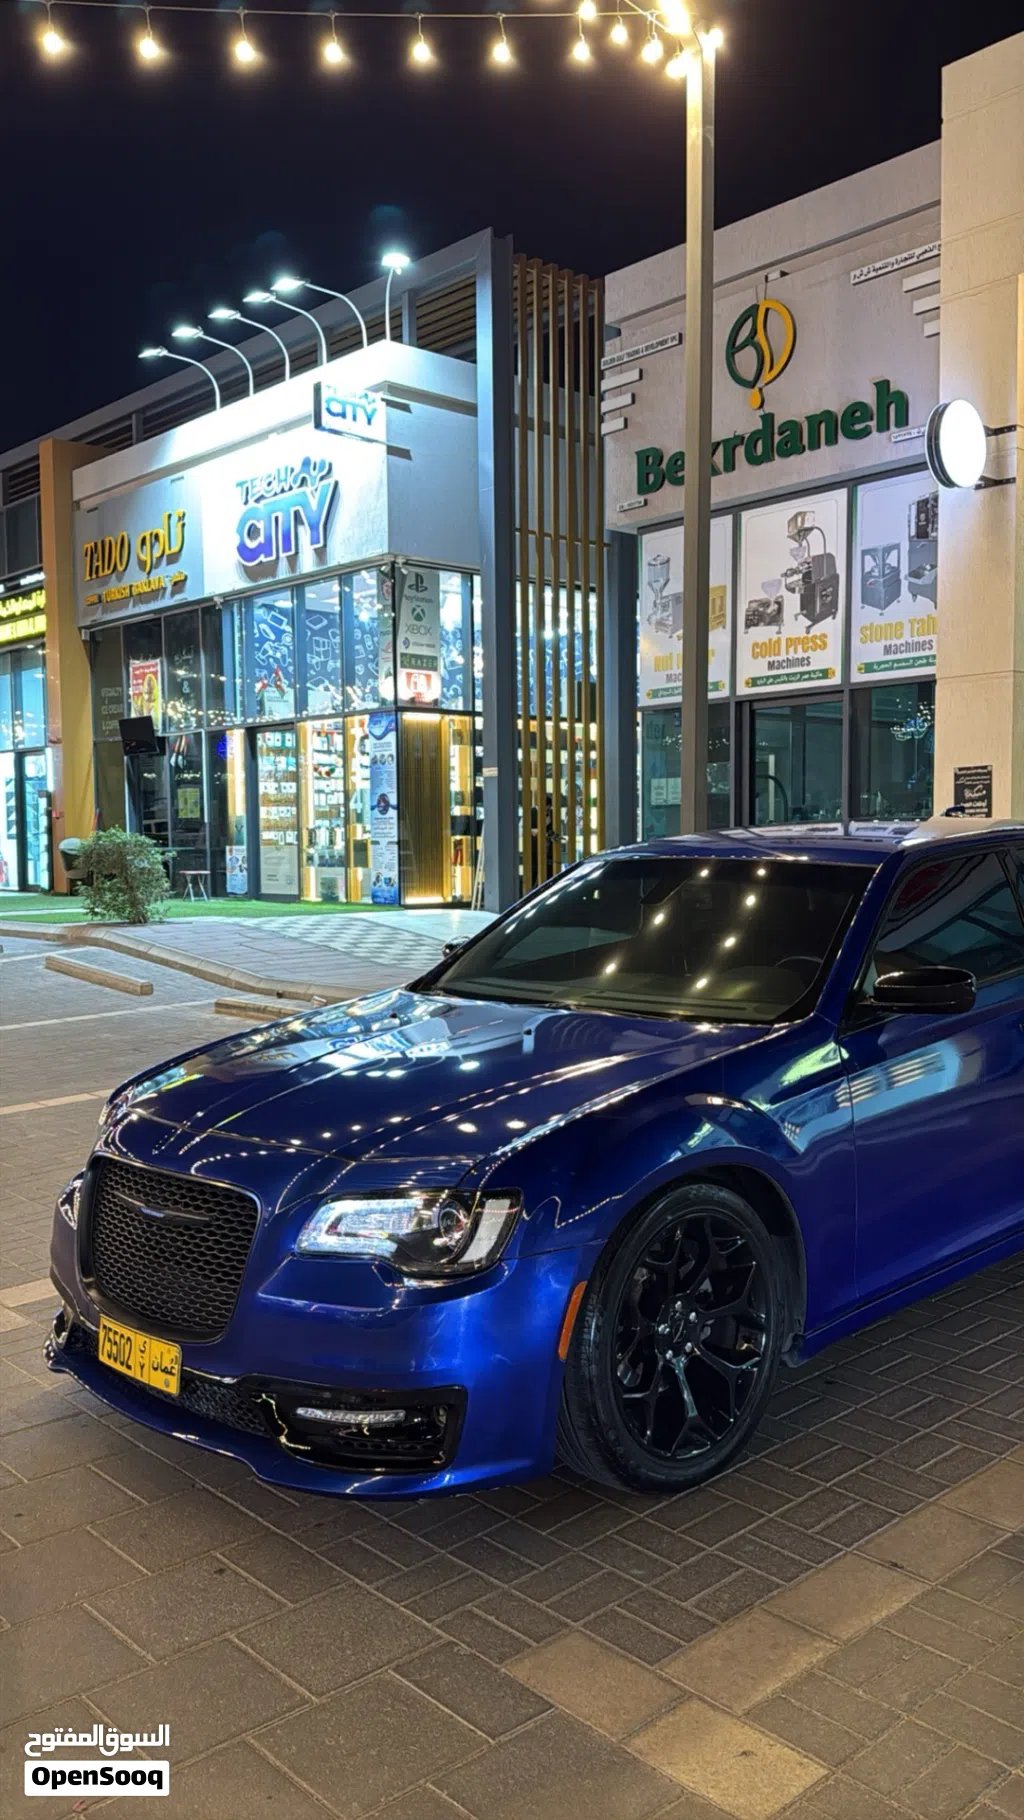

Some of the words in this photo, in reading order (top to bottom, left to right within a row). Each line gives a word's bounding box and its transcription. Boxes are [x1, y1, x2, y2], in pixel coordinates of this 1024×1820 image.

[136, 509, 186, 575] تادو
[84, 531, 130, 581] TADO
[103, 585, 130, 603] TURKISH
[405, 623, 433, 636] XBOX
[860, 621, 905, 645] Stone
[751, 636, 782, 660] Cold
[785, 632, 828, 656] Press
[883, 639, 934, 656] Machines
[767, 656, 811, 671] Machines
[101, 1324, 132, 1371] 75502
[151, 1351, 177, 1376] عمان
